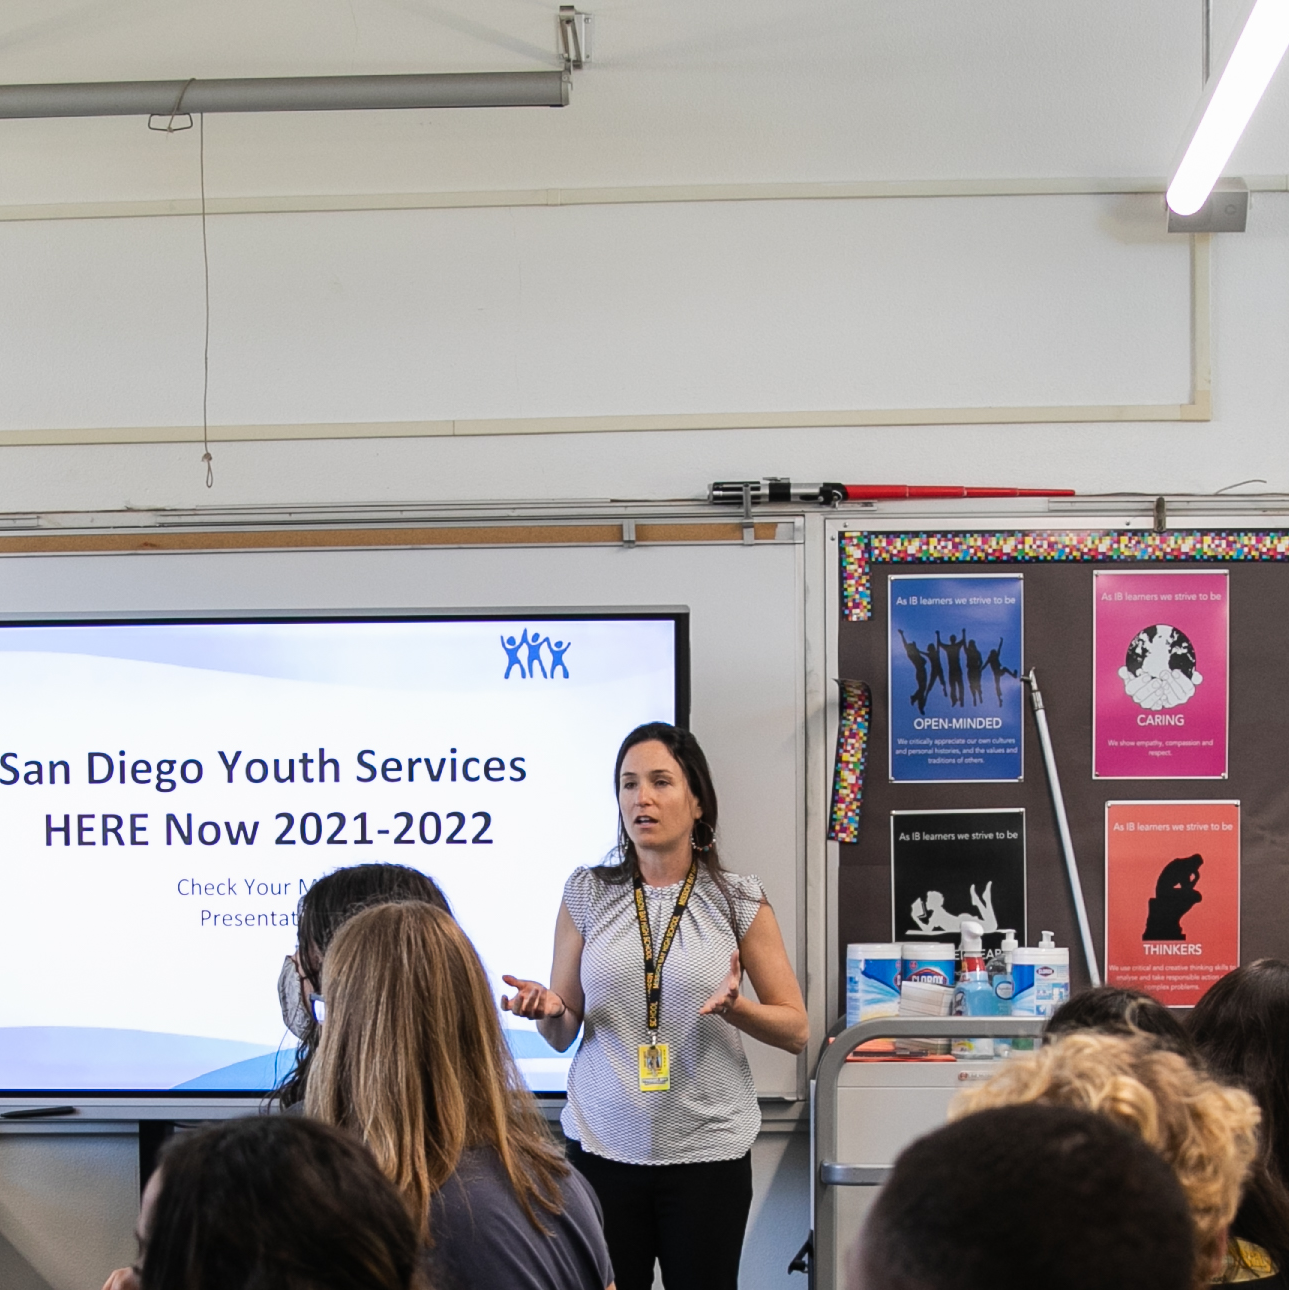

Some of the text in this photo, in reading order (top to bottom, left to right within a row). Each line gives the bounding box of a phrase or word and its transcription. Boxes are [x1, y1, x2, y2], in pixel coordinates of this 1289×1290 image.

[896, 596, 907, 605] As
[909, 595, 918, 605] IB
[920, 595, 952, 605] learners
[969, 596, 991, 604] strive
[1005, 595, 1015, 604] be
[1102, 591, 1112, 600] As
[1114, 591, 1123, 600] IB
[1125, 591, 1158, 600] learners
[1174, 591, 1197, 600] strive
[1210, 591, 1222, 600] be
[913, 717, 1003, 730] OPEN-MINDED
[1137, 714, 1185, 726] CARING
[0, 748, 527, 792] San Diego Youth Services
[45, 811, 494, 846] HERE Now 2021-2022
[1113, 821, 1233, 831] As IB learners we strive to be
[899, 831, 910, 840] As
[912, 831, 920, 840] IB
[923, 831, 955, 840] learners
[972, 830, 994, 840] strive
[996, 831, 1005, 839] to
[1007, 829, 1018, 839] be
[177, 878, 238, 896] Check
[244, 878, 291, 896] Your
[201, 910, 298, 927] Presentat
[1143, 944, 1202, 955] THINKERS
